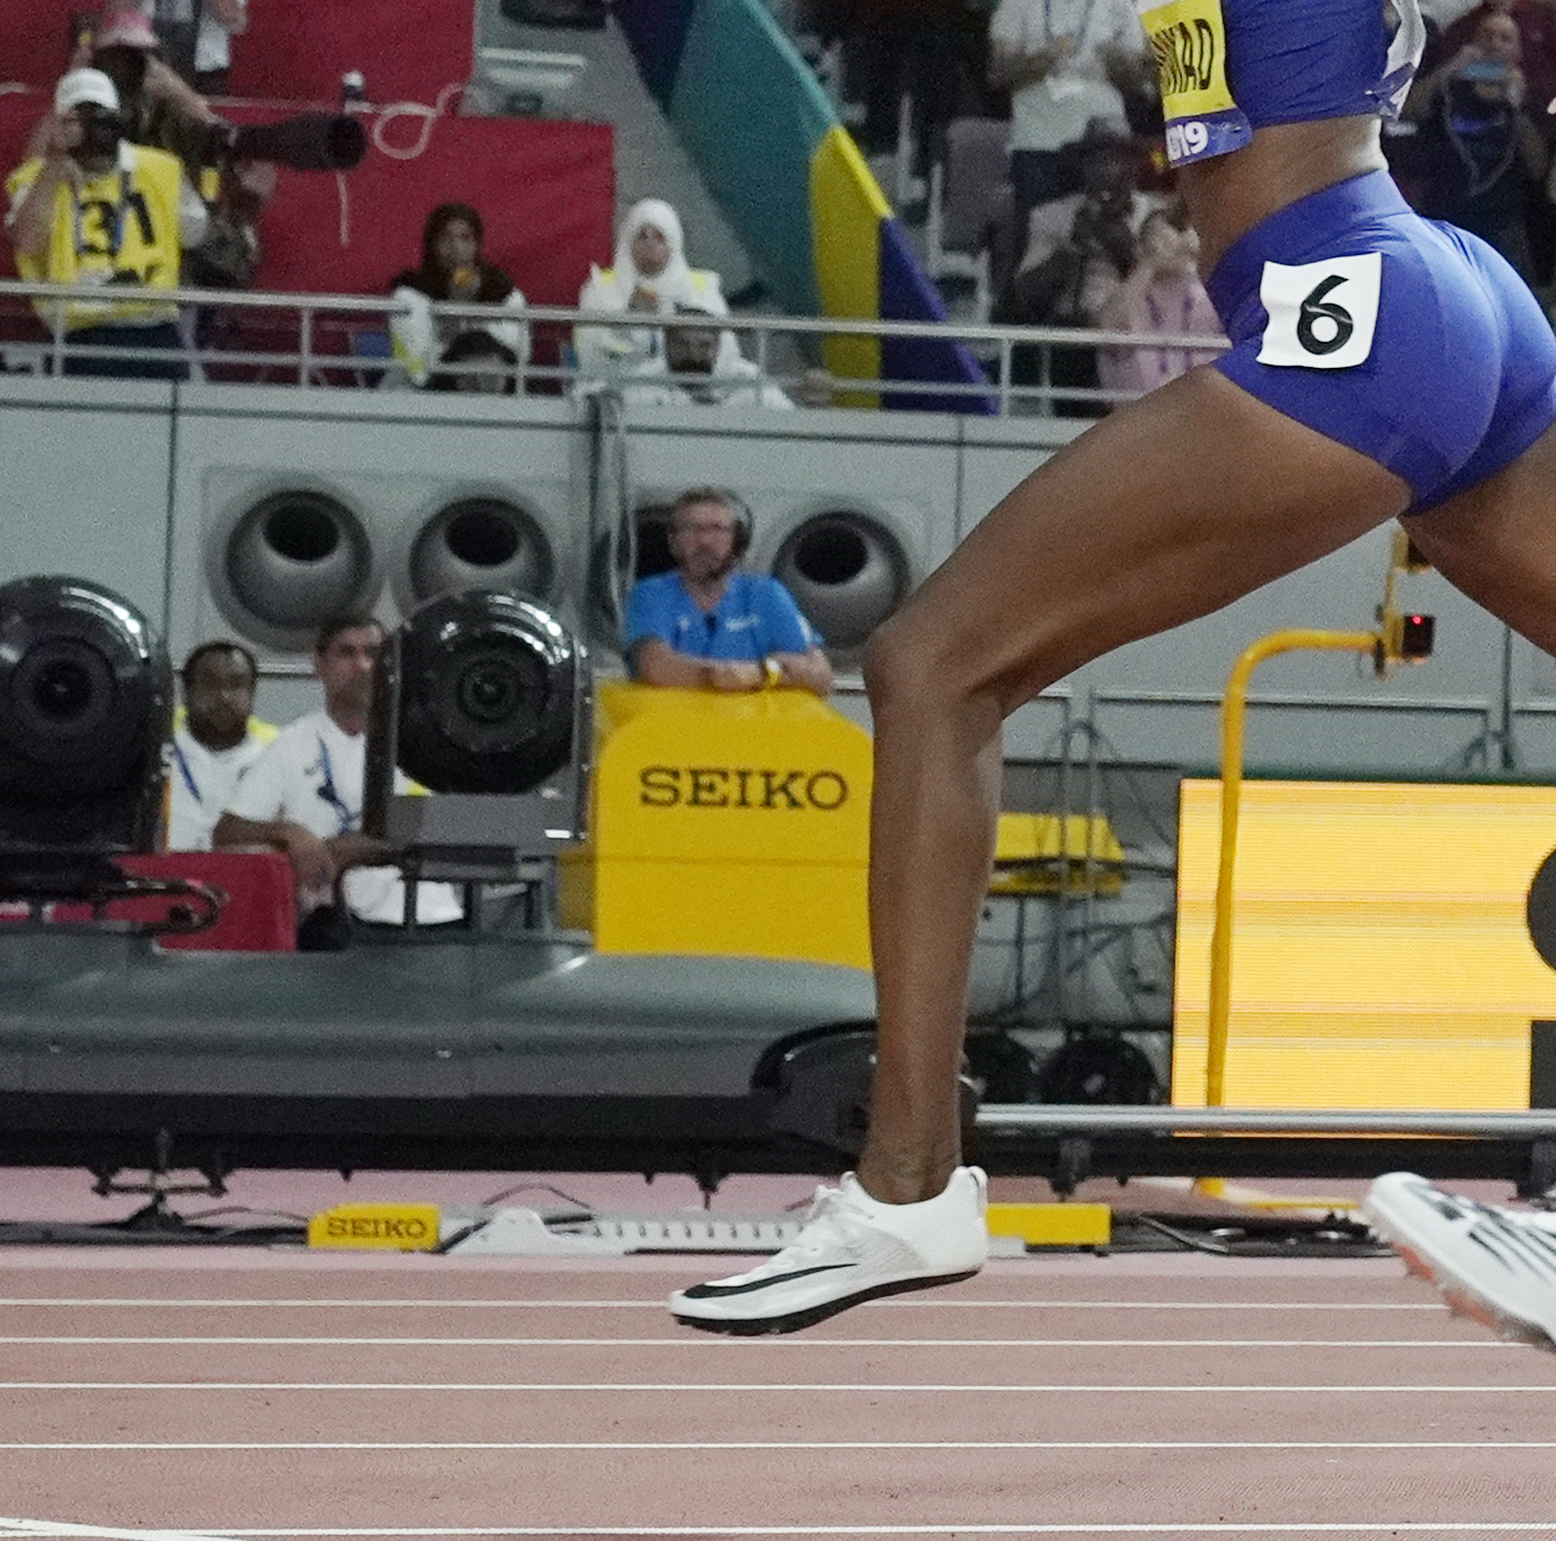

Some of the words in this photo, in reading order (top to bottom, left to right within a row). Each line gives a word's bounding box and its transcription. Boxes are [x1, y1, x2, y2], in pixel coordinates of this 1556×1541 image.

[1296, 274, 1354, 356] 6
[640, 764, 848, 810] SEIKO
[327, 1216, 427, 1239] SEIKO
